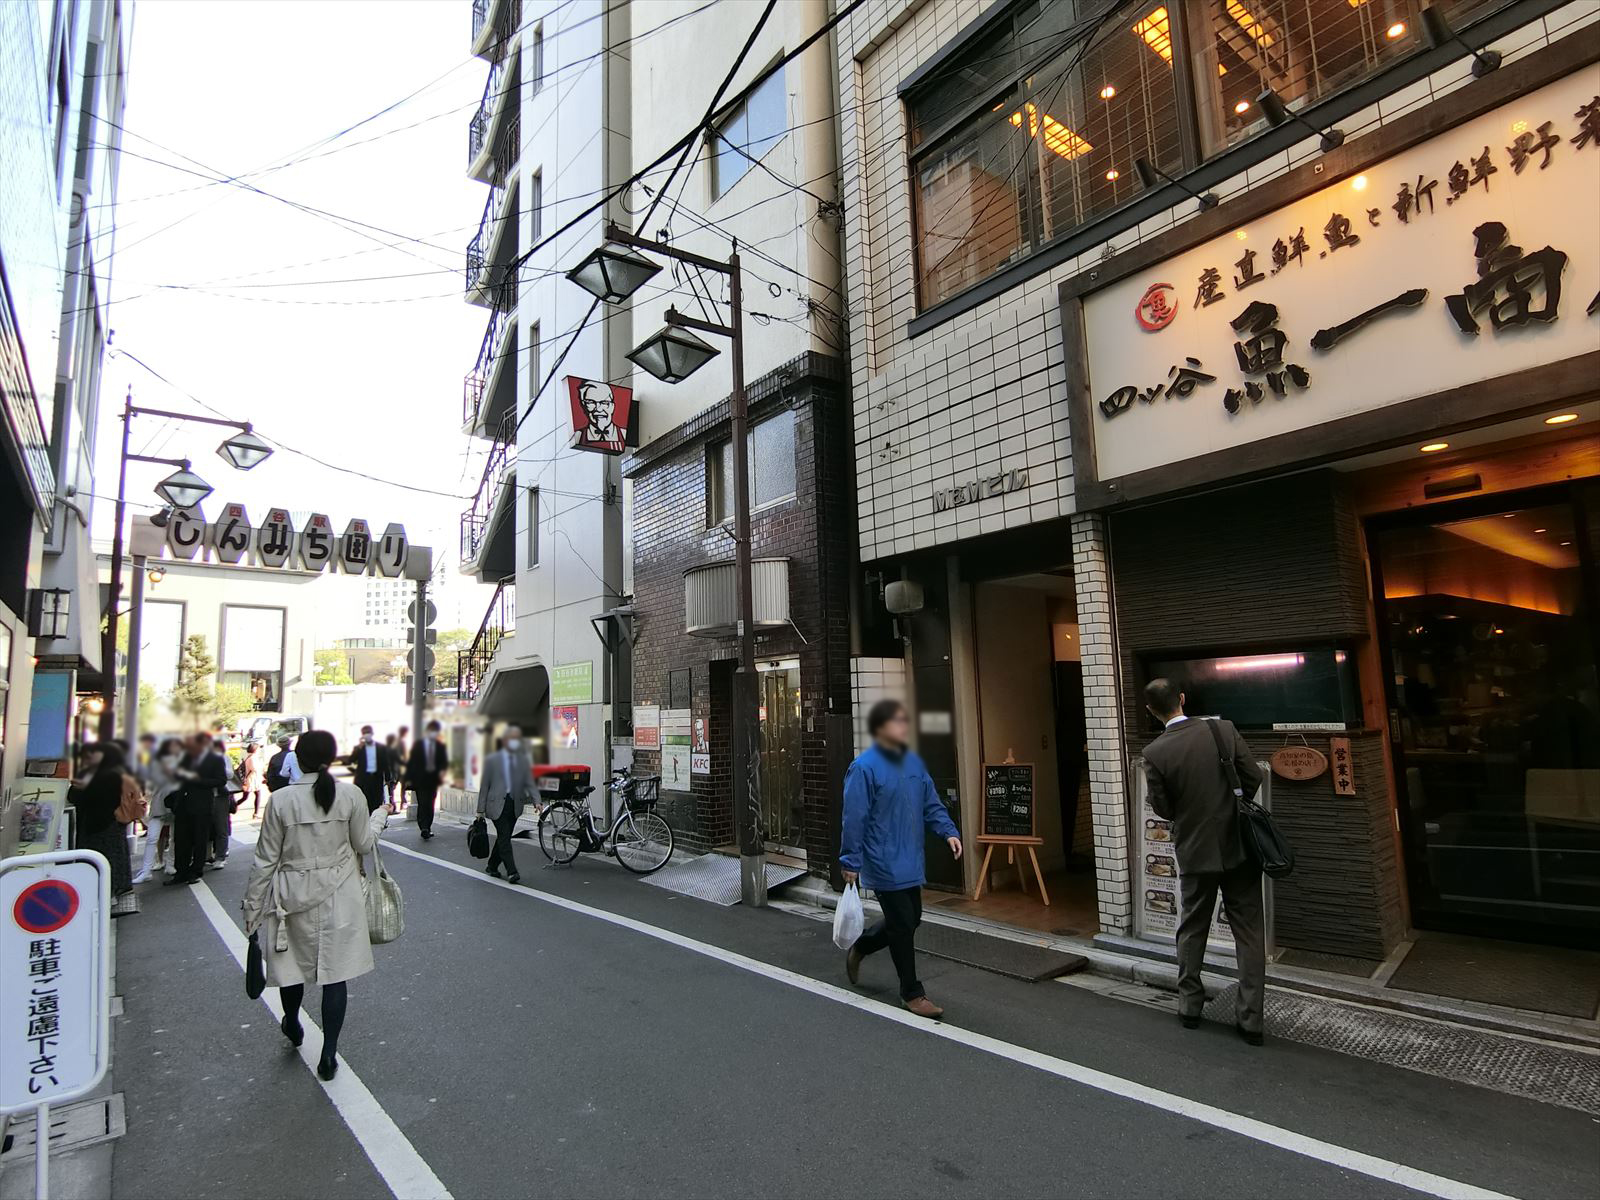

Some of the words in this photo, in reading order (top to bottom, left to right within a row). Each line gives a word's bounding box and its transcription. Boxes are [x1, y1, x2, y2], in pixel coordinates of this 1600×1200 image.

[1223, 222, 1600, 415] 魚一商
[694, 759, 708, 769] KFC
[1335, 748, 1350, 791] 営業中
[28, 938, 61, 1094] 駐車ご遠慮下さい
